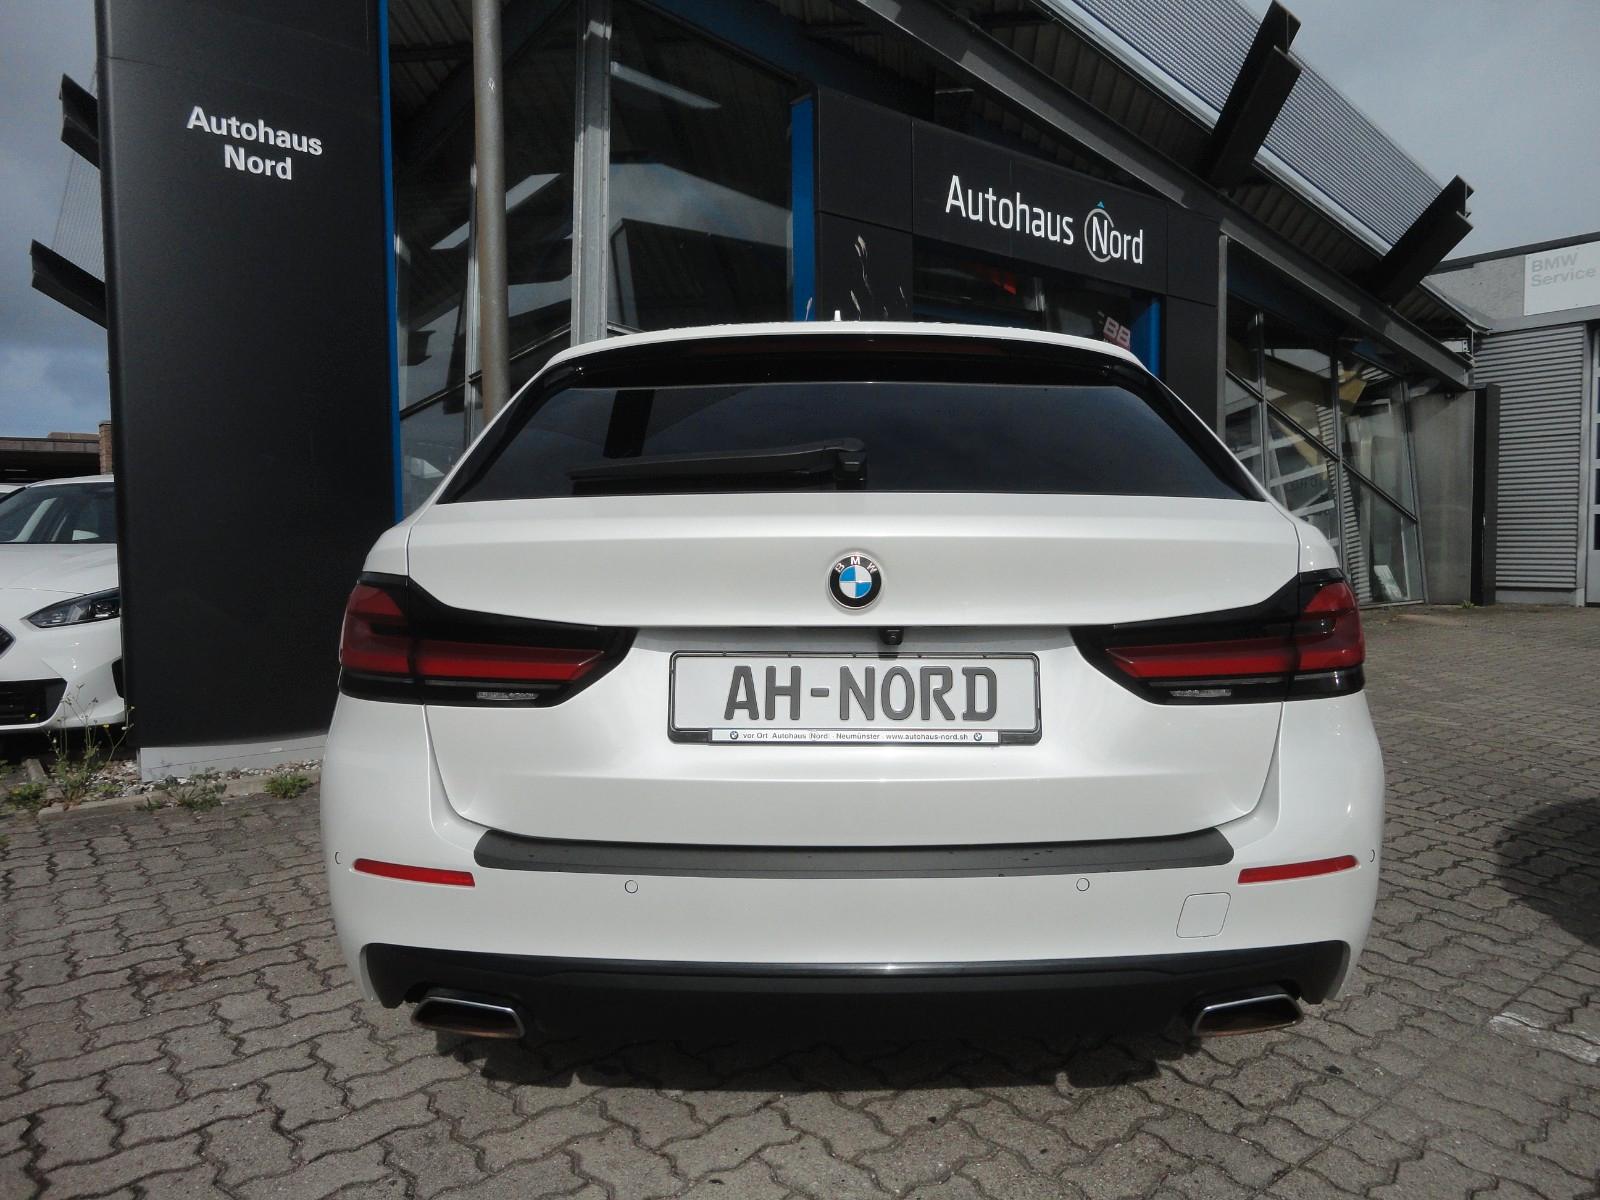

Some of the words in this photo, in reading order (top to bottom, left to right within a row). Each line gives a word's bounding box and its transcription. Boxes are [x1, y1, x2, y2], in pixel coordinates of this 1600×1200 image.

[186, 105, 323, 156] Autohaus
[224, 144, 292, 180] Nord
[945, 174, 1074, 245] Autohaus
[1092, 215, 1143, 264] Nord
[1531, 252, 1578, 272] BMW
[1531, 267, 1597, 287] Service
[835, 555, 878, 574] BMW
[723, 665, 998, 721] AH-NORD
[742, 732, 755, 740] vor
[756, 732, 768, 740] Ort
[772, 732, 807, 740] Autohaus
[810, 731, 828, 741] Nord
[836, 731, 880, 740] Neumünster
[885, 732, 969, 741] www.autohaus-nord.sh
